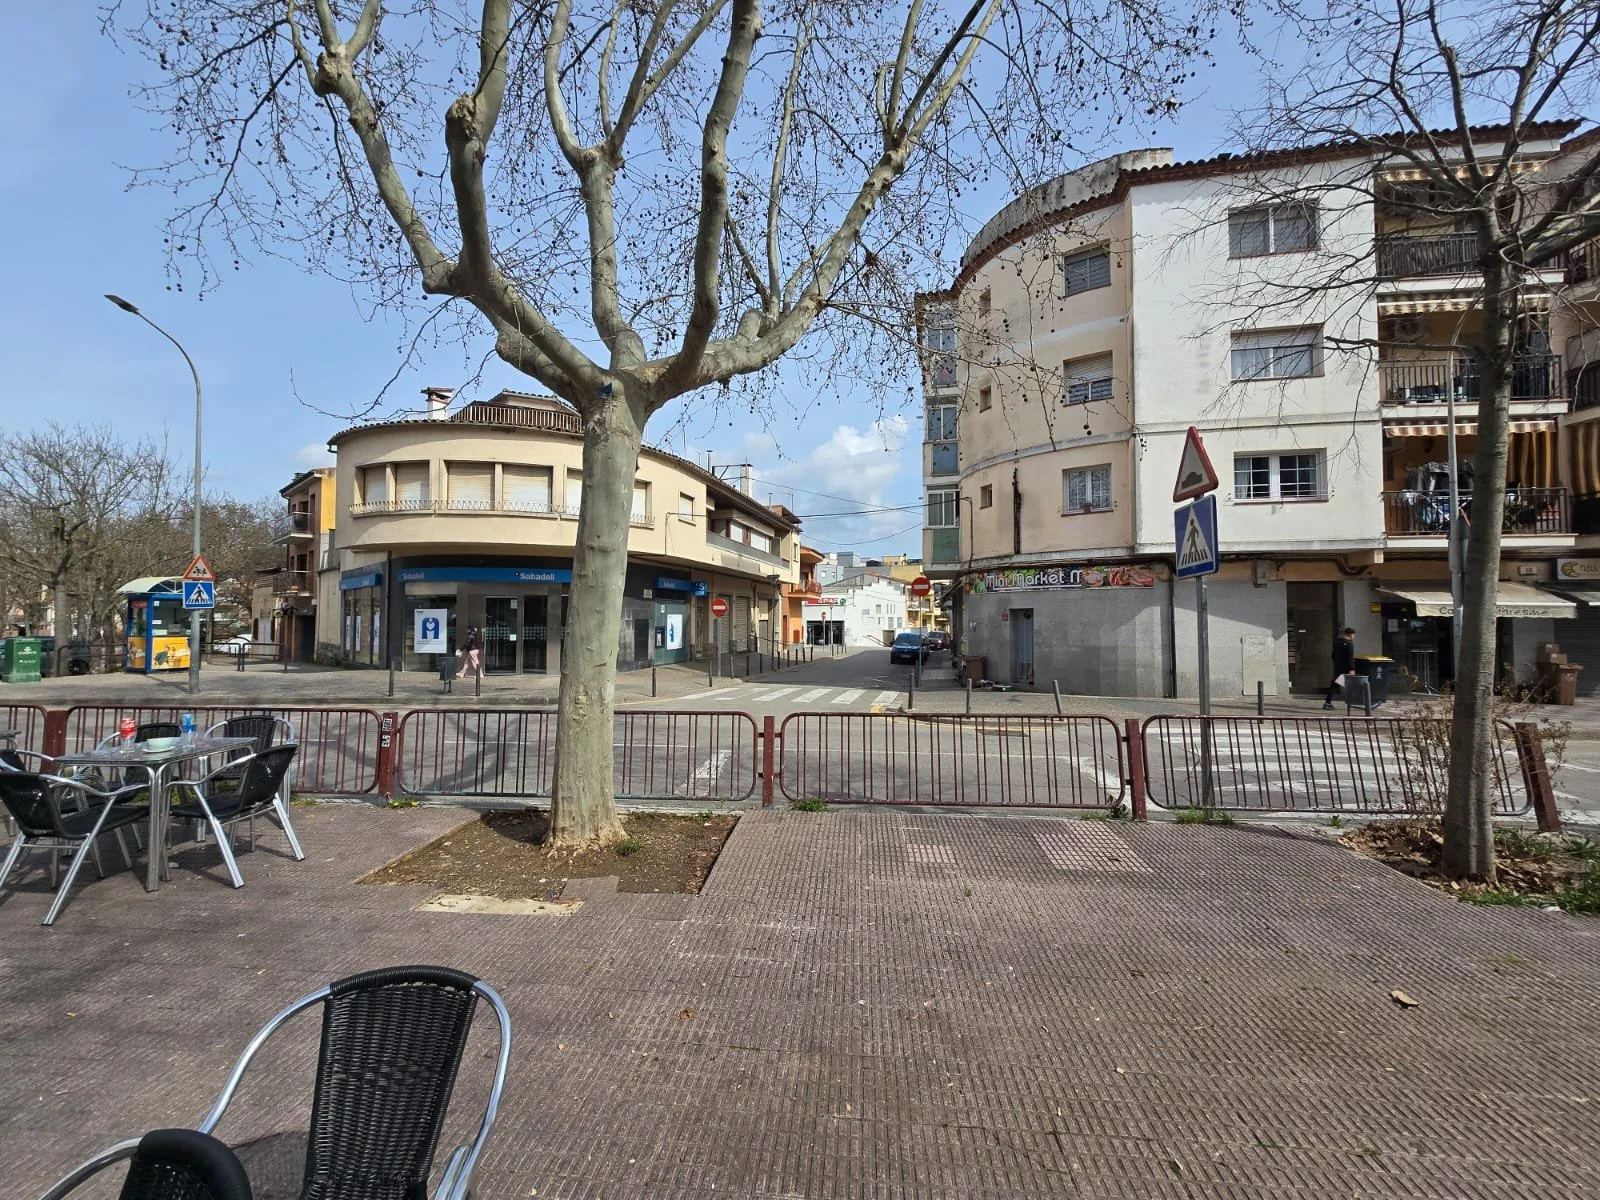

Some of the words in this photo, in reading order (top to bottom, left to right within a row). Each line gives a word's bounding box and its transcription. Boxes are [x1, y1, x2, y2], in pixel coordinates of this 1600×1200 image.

[519, 572, 555, 581] Sabadell
[985, 574, 1008, 588] Mini
[1012, 571, 1064, 586] Market
